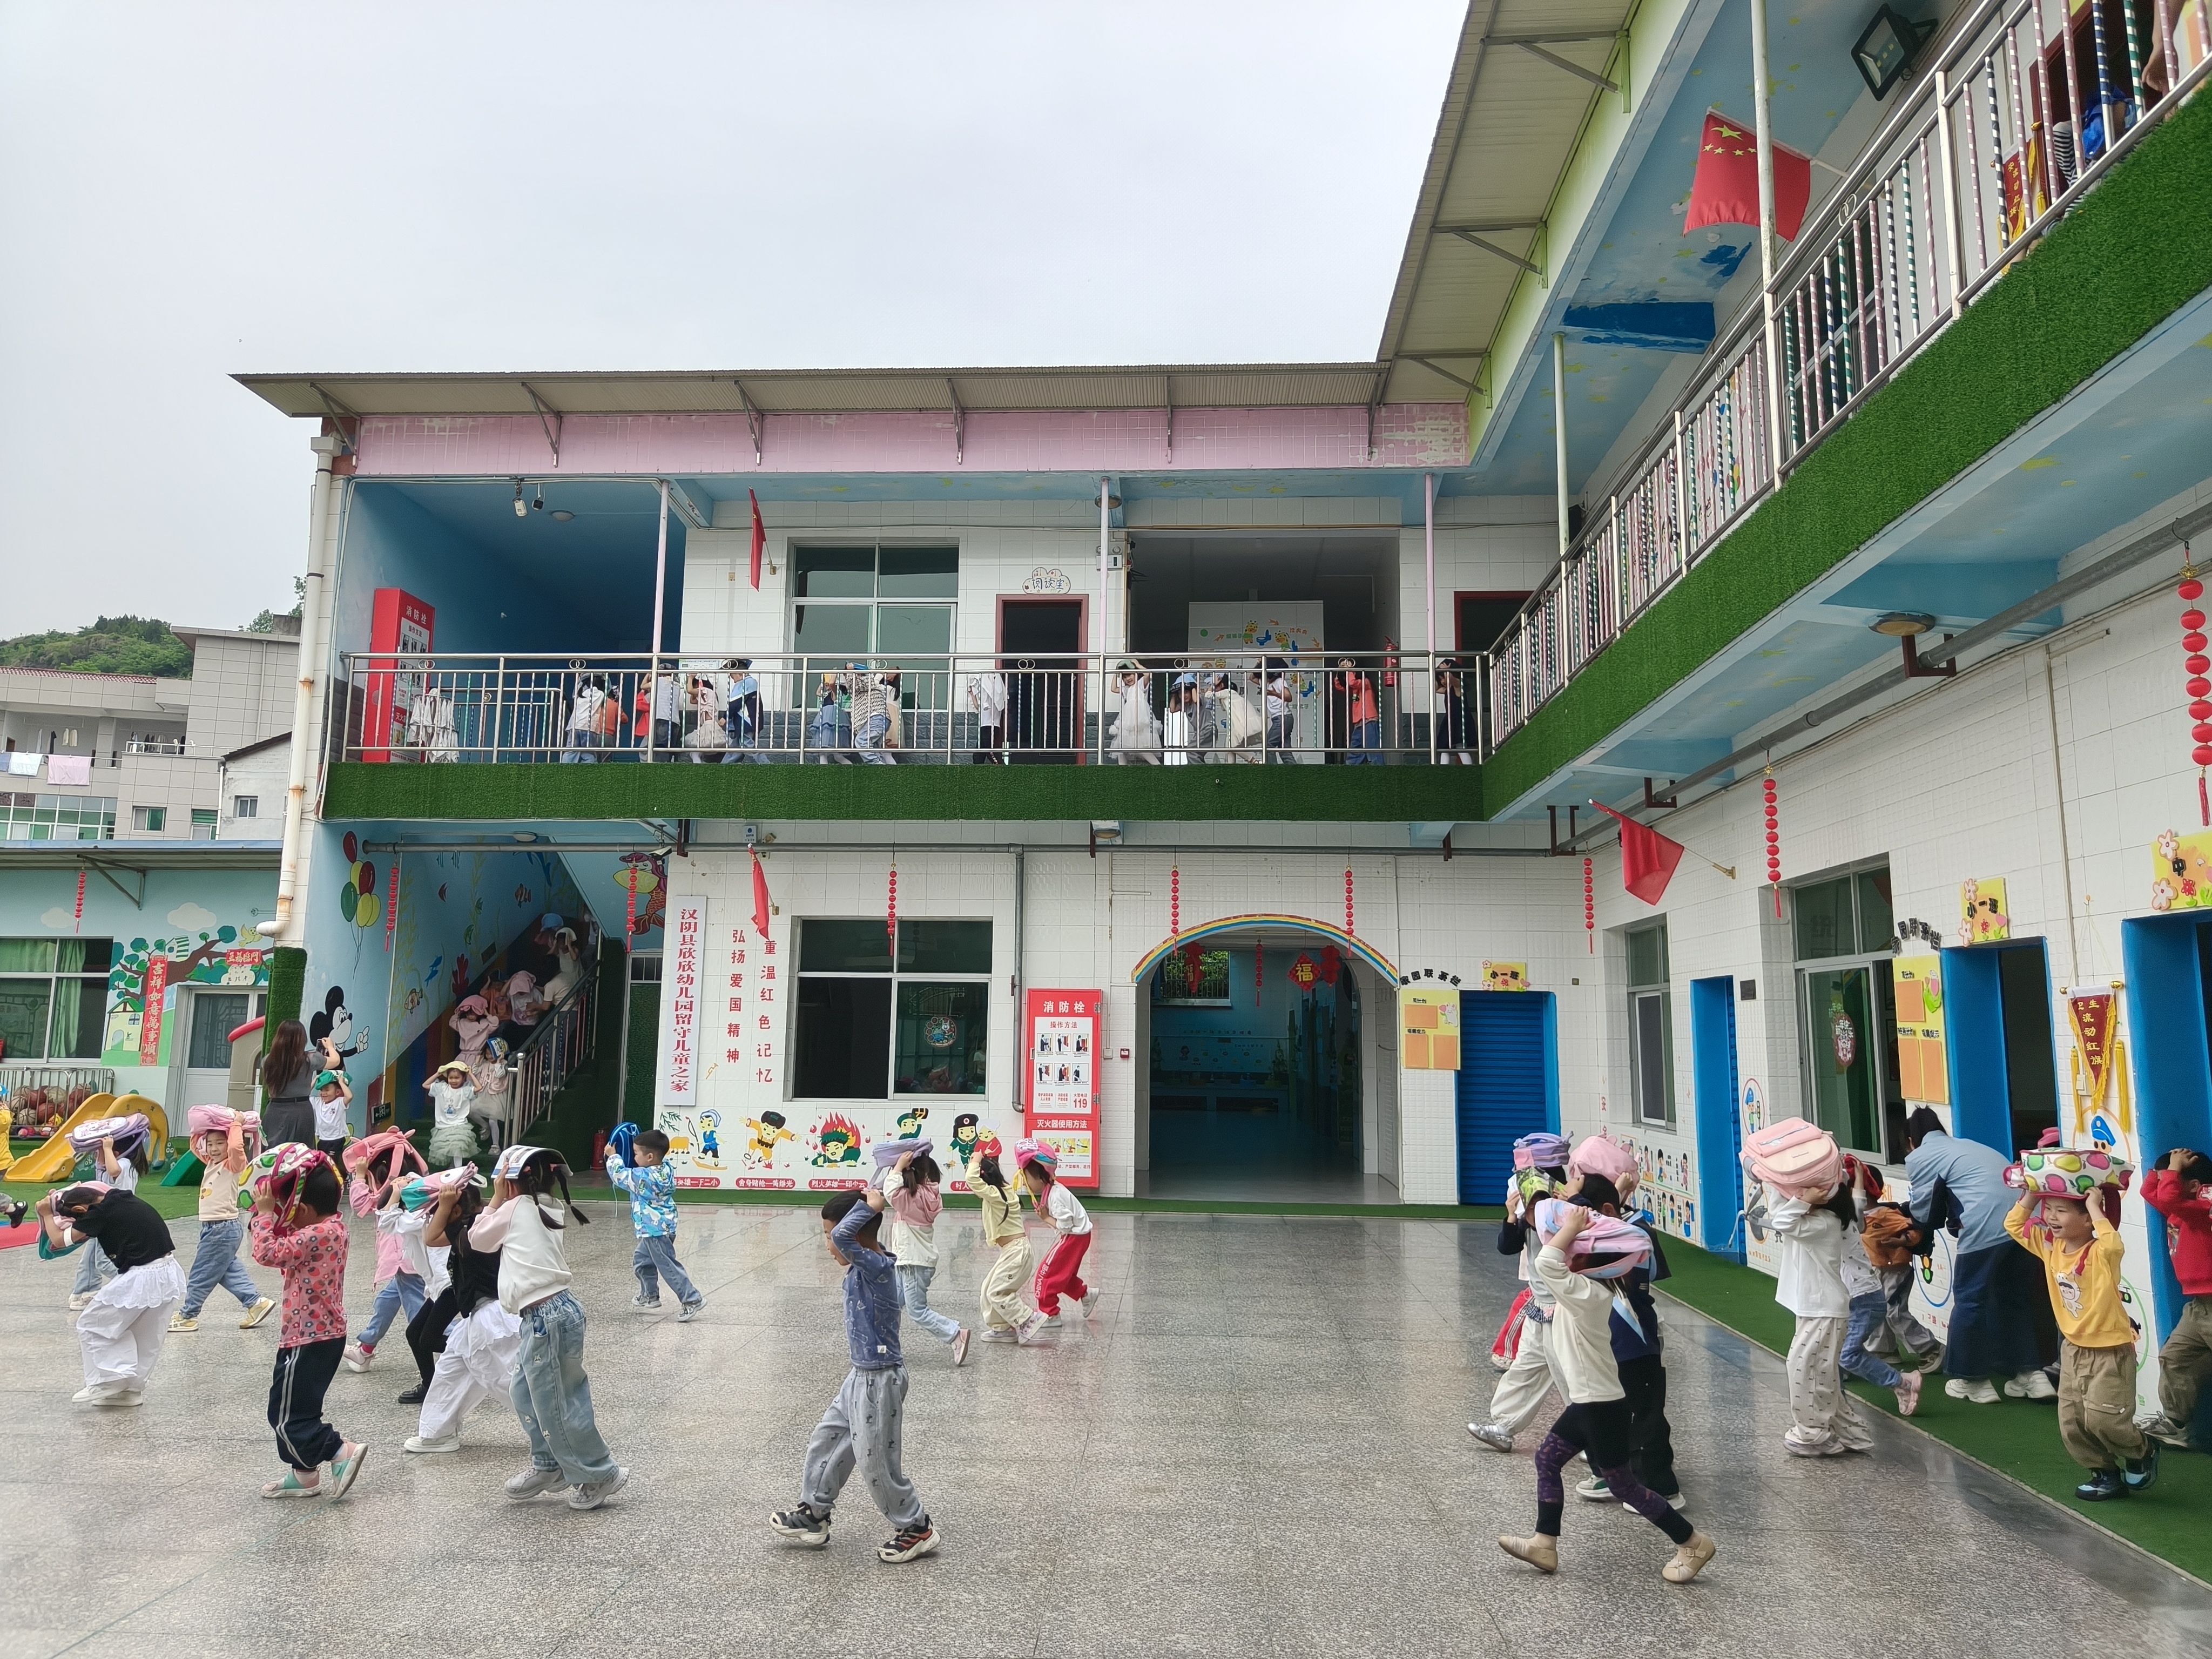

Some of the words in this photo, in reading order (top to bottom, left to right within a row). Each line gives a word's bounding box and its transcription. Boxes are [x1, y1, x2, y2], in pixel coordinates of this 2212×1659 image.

[1032, 578, 1064, 590] 阅读室
[406, 605, 427, 624] 消防栓
[2172, 857, 2186, 877] 中
[1296, 963, 1313, 982] 福
[1491, 970, 1519, 980] 小一班
[670, 908, 698, 1092] 汉阴县欣欣幼儿园留守儿童之家
[726, 929, 746, 1063] 弘扬爱国精神
[2077, 999, 2100, 1010] 卫生
[756, 940, 777, 1083] 重温红色记忆
[1043, 1001, 1085, 1013] 消防栓
[2082, 1013, 2102, 1065] 流动红旗
[1074, 1098, 1088, 1108] 119
[1037, 1119, 1088, 1129] 灭火器使用方法
